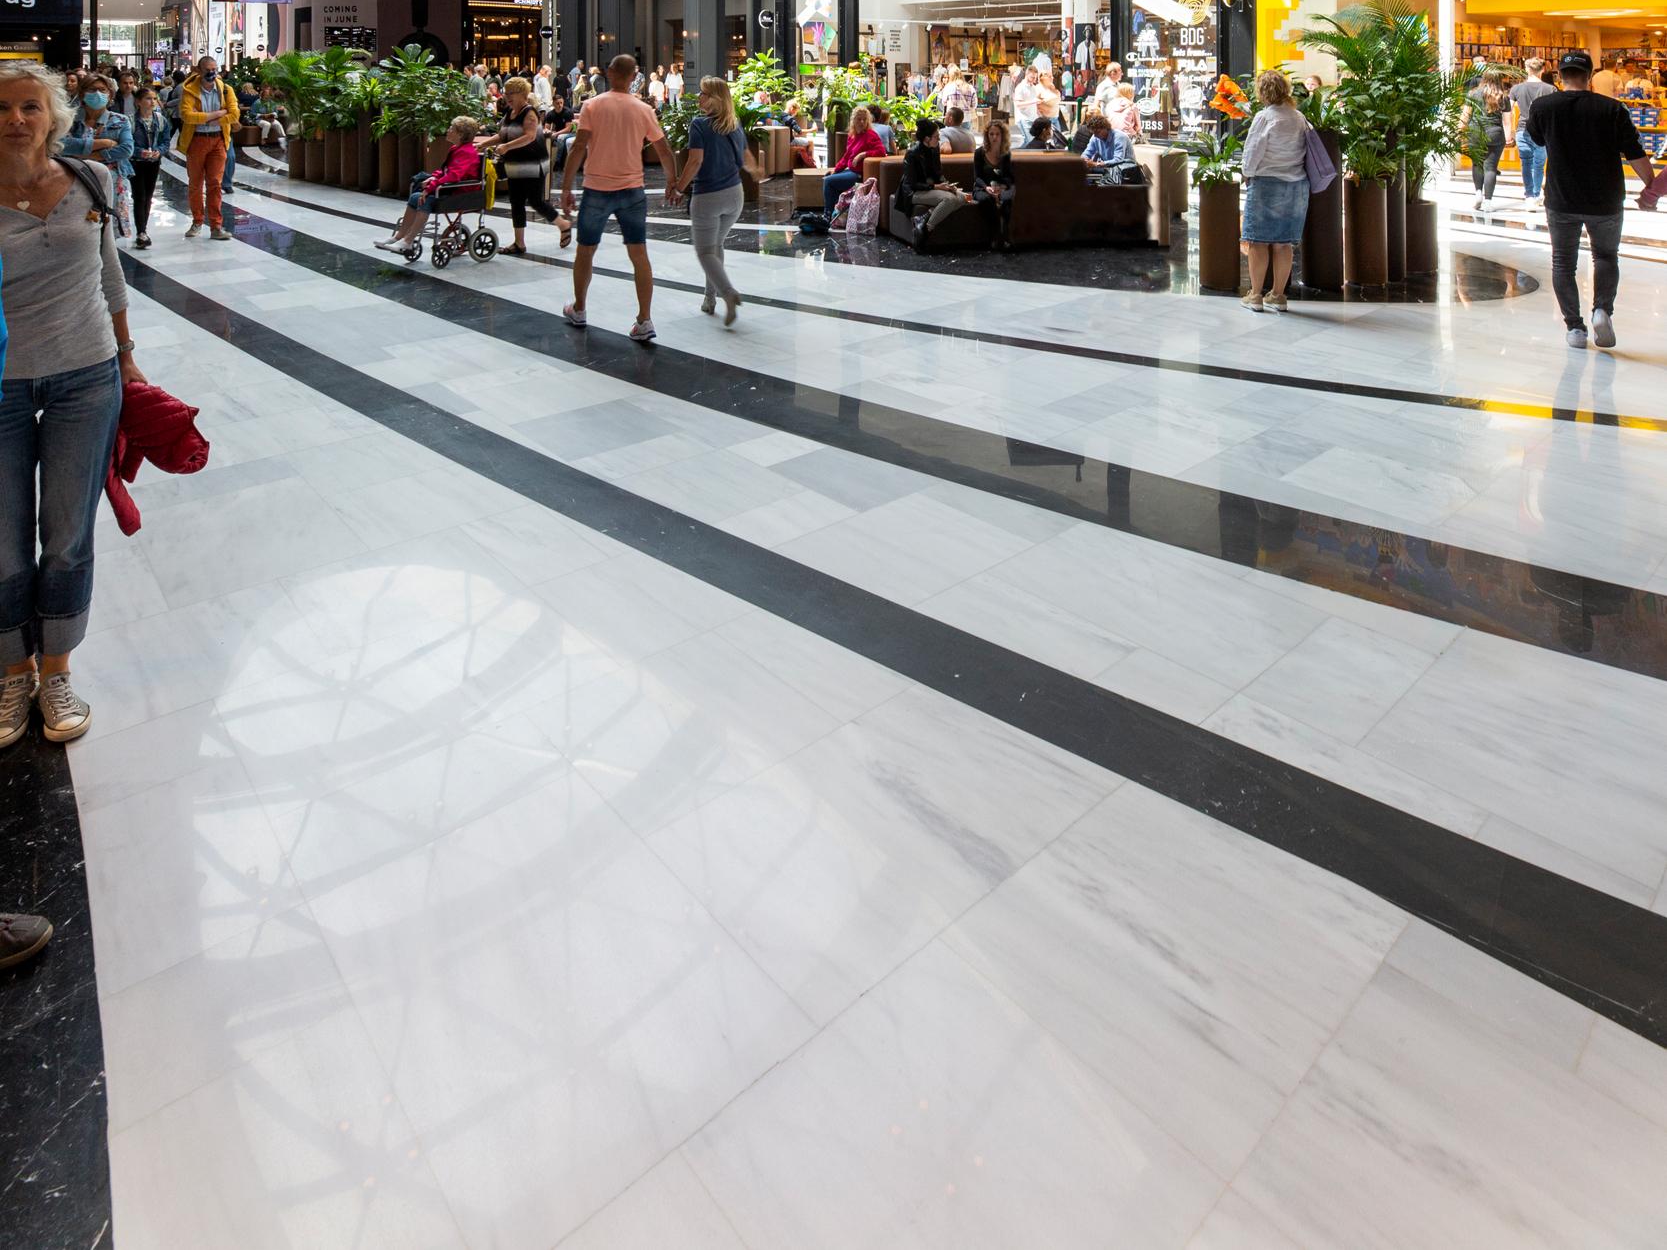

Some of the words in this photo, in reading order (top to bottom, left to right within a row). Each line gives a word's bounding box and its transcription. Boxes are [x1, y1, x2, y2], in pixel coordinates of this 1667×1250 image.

[323, 5, 358, 13] COMING
[335, 15, 358, 23] JUNE
[1180, 28, 1204, 46] BDG
